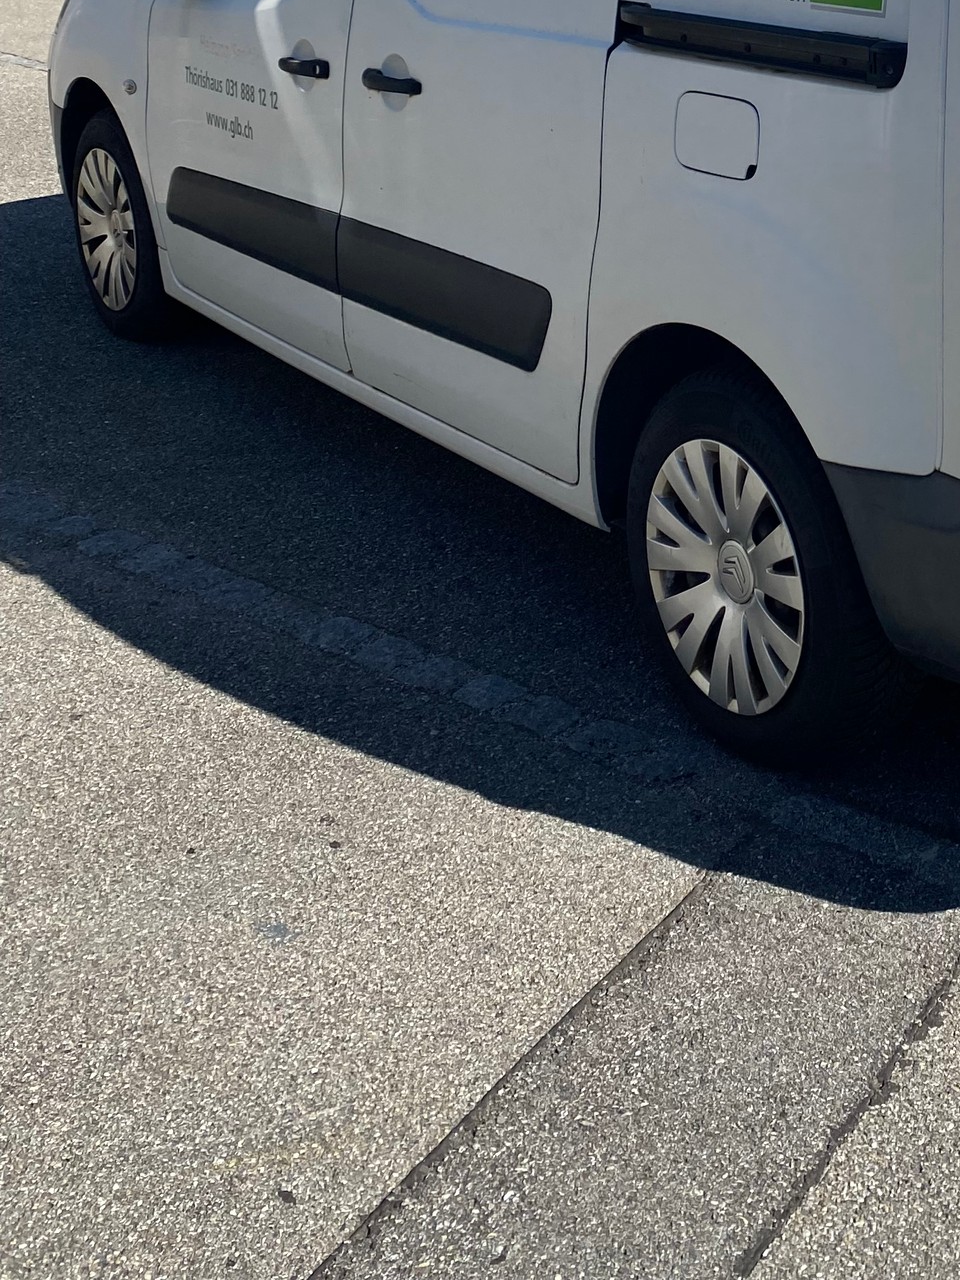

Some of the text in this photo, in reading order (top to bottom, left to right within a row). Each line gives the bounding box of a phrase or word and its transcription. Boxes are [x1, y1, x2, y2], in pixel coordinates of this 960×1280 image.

[185, 66, 279, 110] Thörishaus 031 888 12 12
[206, 111, 254, 140] www.glb.ch
